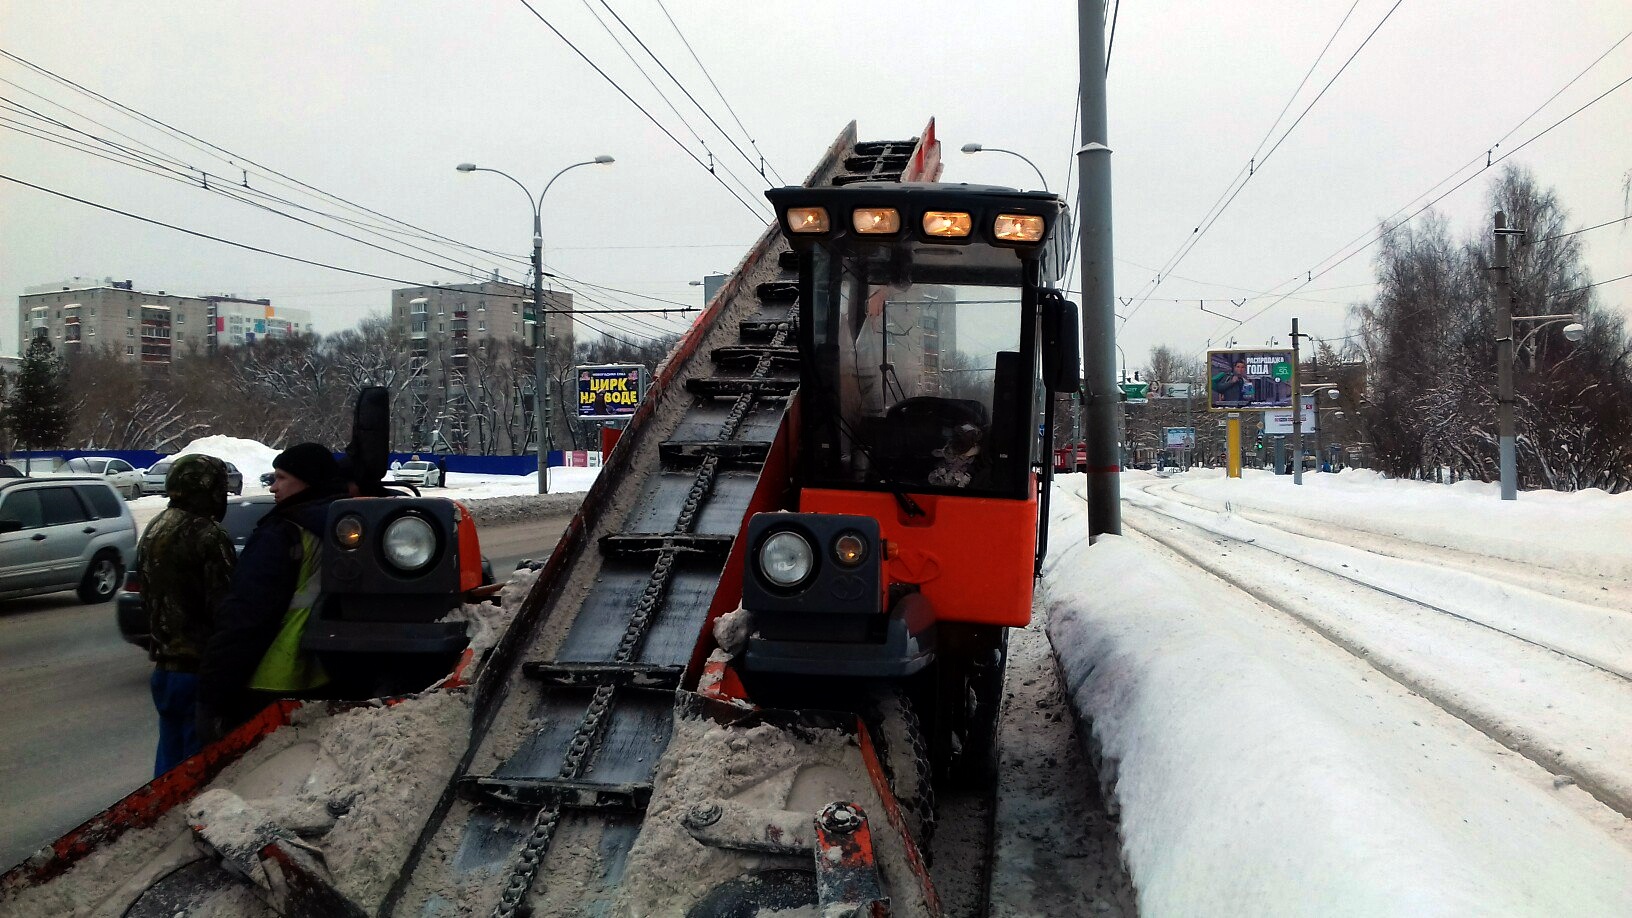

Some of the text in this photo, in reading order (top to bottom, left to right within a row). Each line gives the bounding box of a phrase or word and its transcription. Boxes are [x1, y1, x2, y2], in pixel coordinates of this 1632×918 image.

[1246, 356, 1284, 364] РАСПРОДАЖА
[1246, 364, 1269, 375] ГОДА
[590, 377, 628, 391] ЦИРК
[580, 391, 637, 405] НА ВОДЕ
